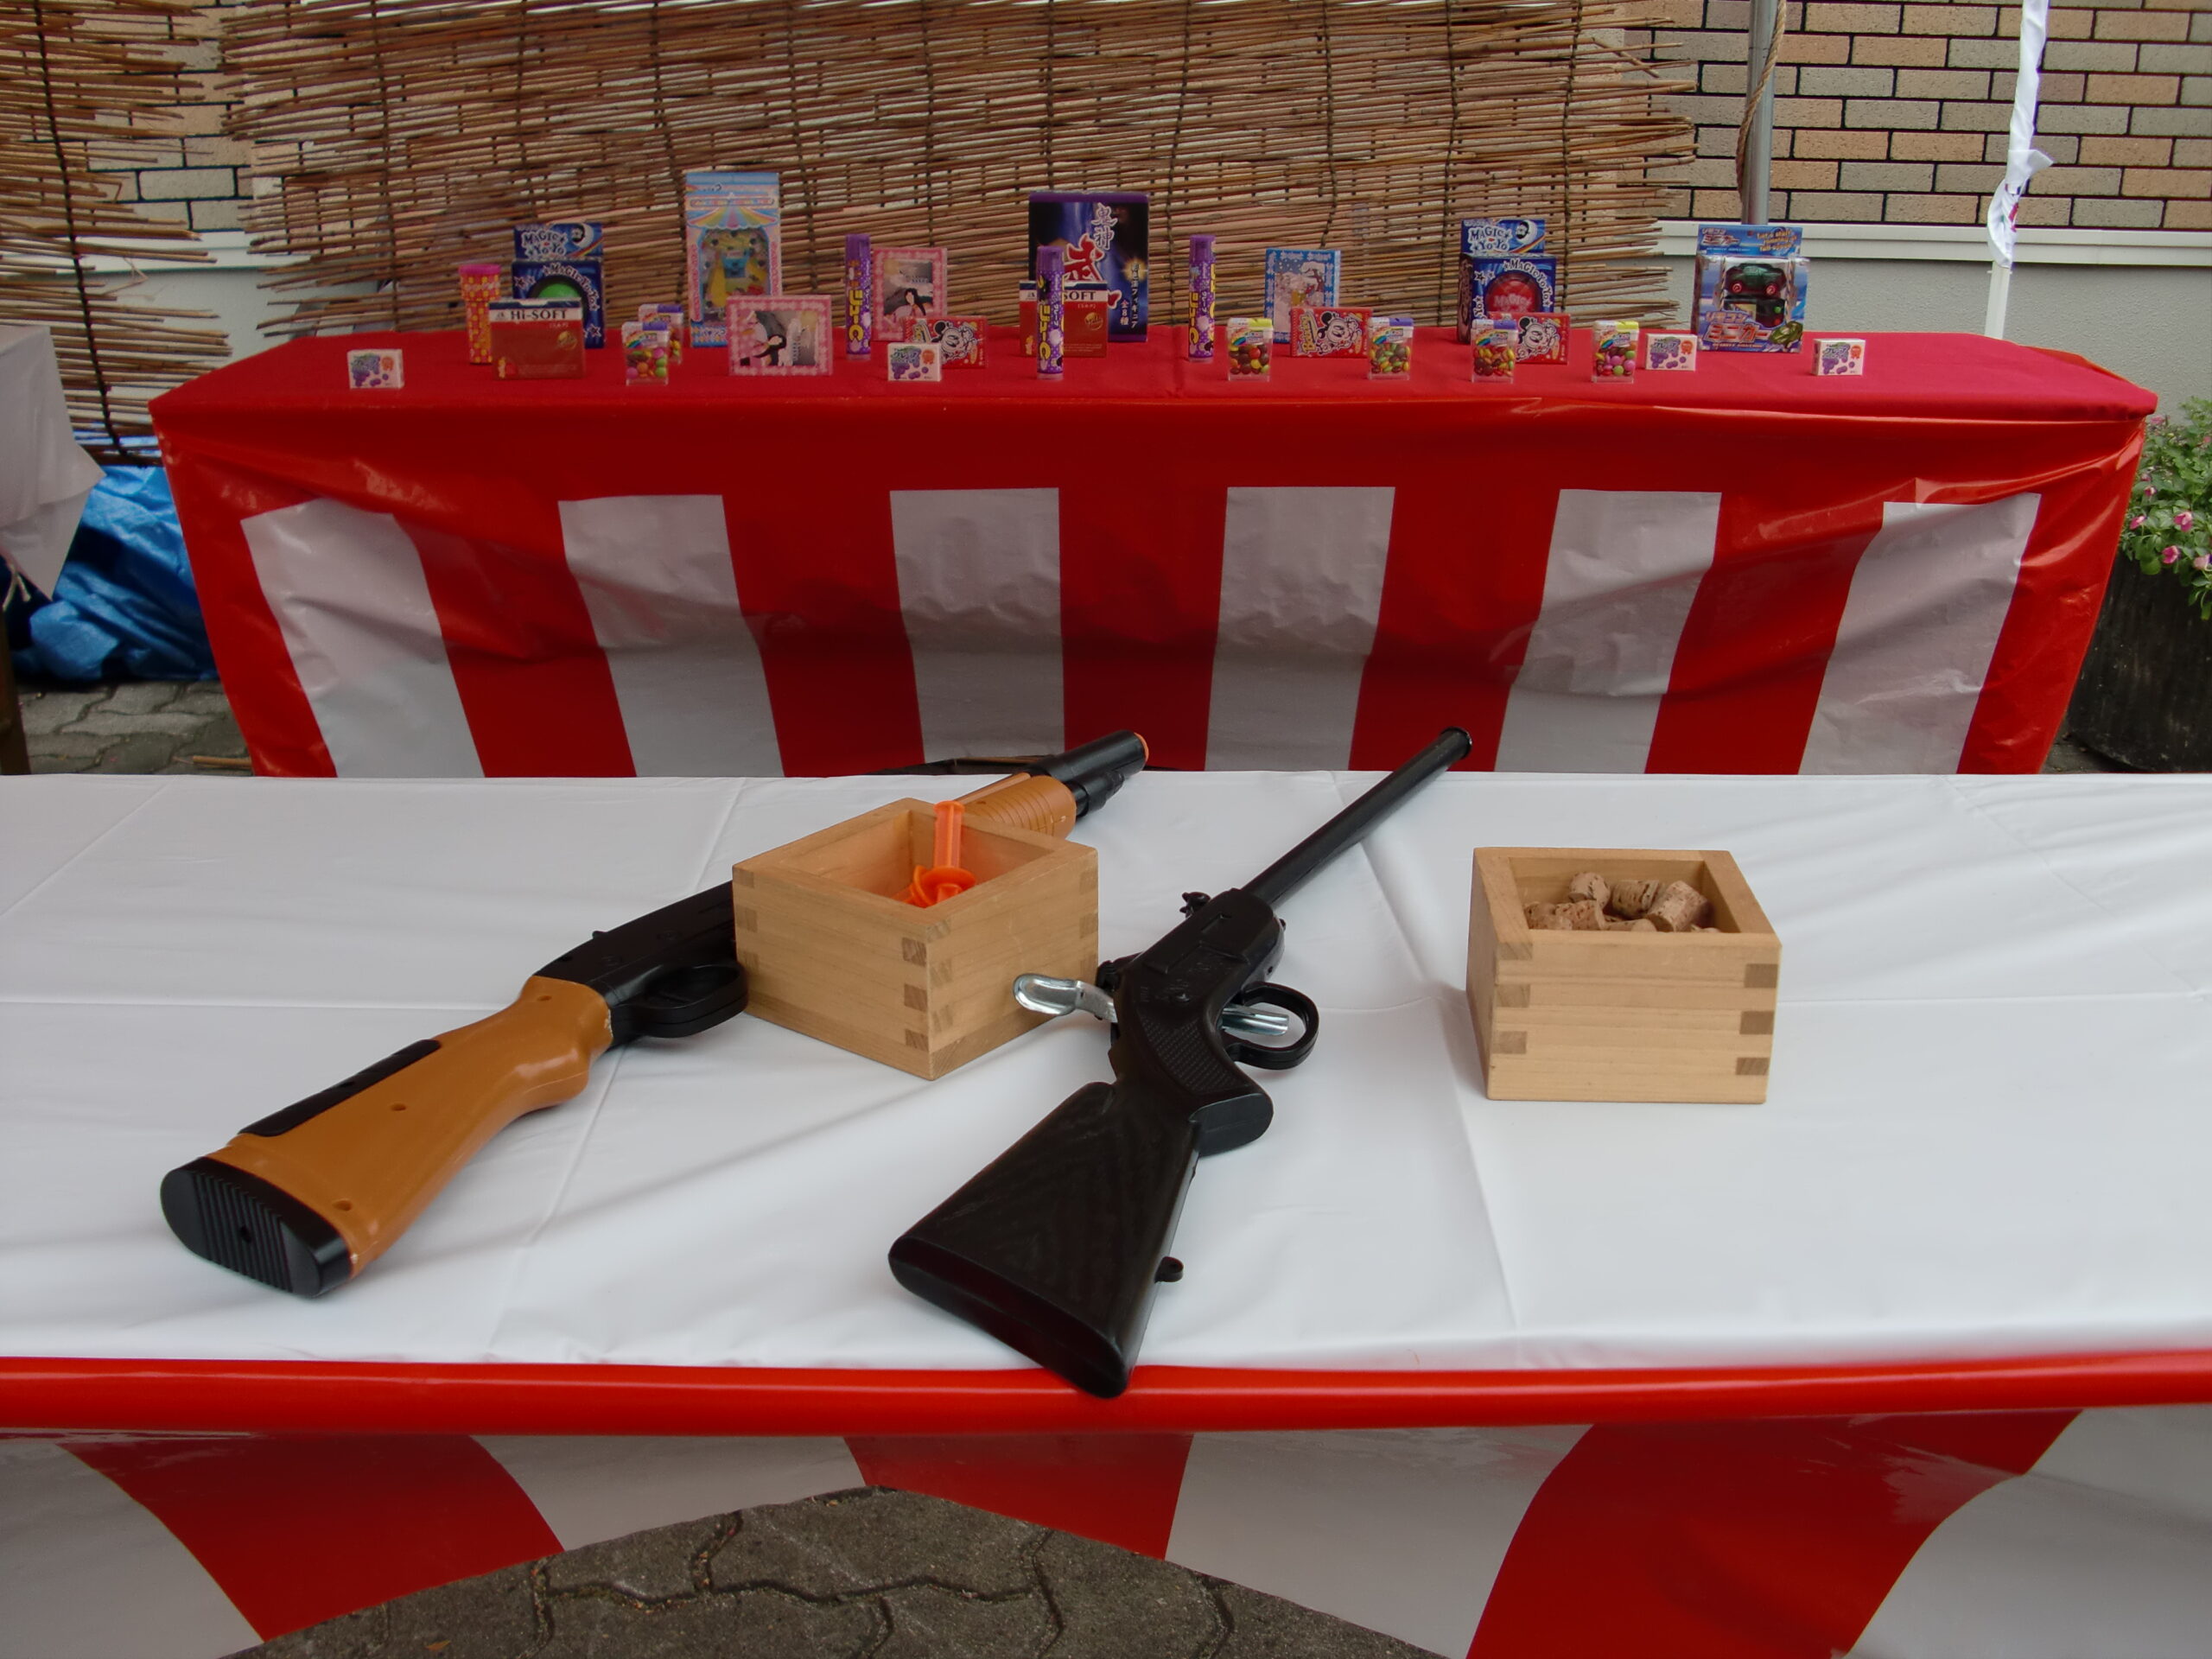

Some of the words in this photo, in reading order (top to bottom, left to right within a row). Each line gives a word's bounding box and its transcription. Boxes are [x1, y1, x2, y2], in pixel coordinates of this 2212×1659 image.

[524, 231, 559, 244] MAGIC
[1470, 226, 1505, 242] MAGIC
[511, 309, 567, 321] Hi-SOFT
[1705, 312, 1748, 323] リモコン
[1703, 324, 1771, 342] ミニカー
